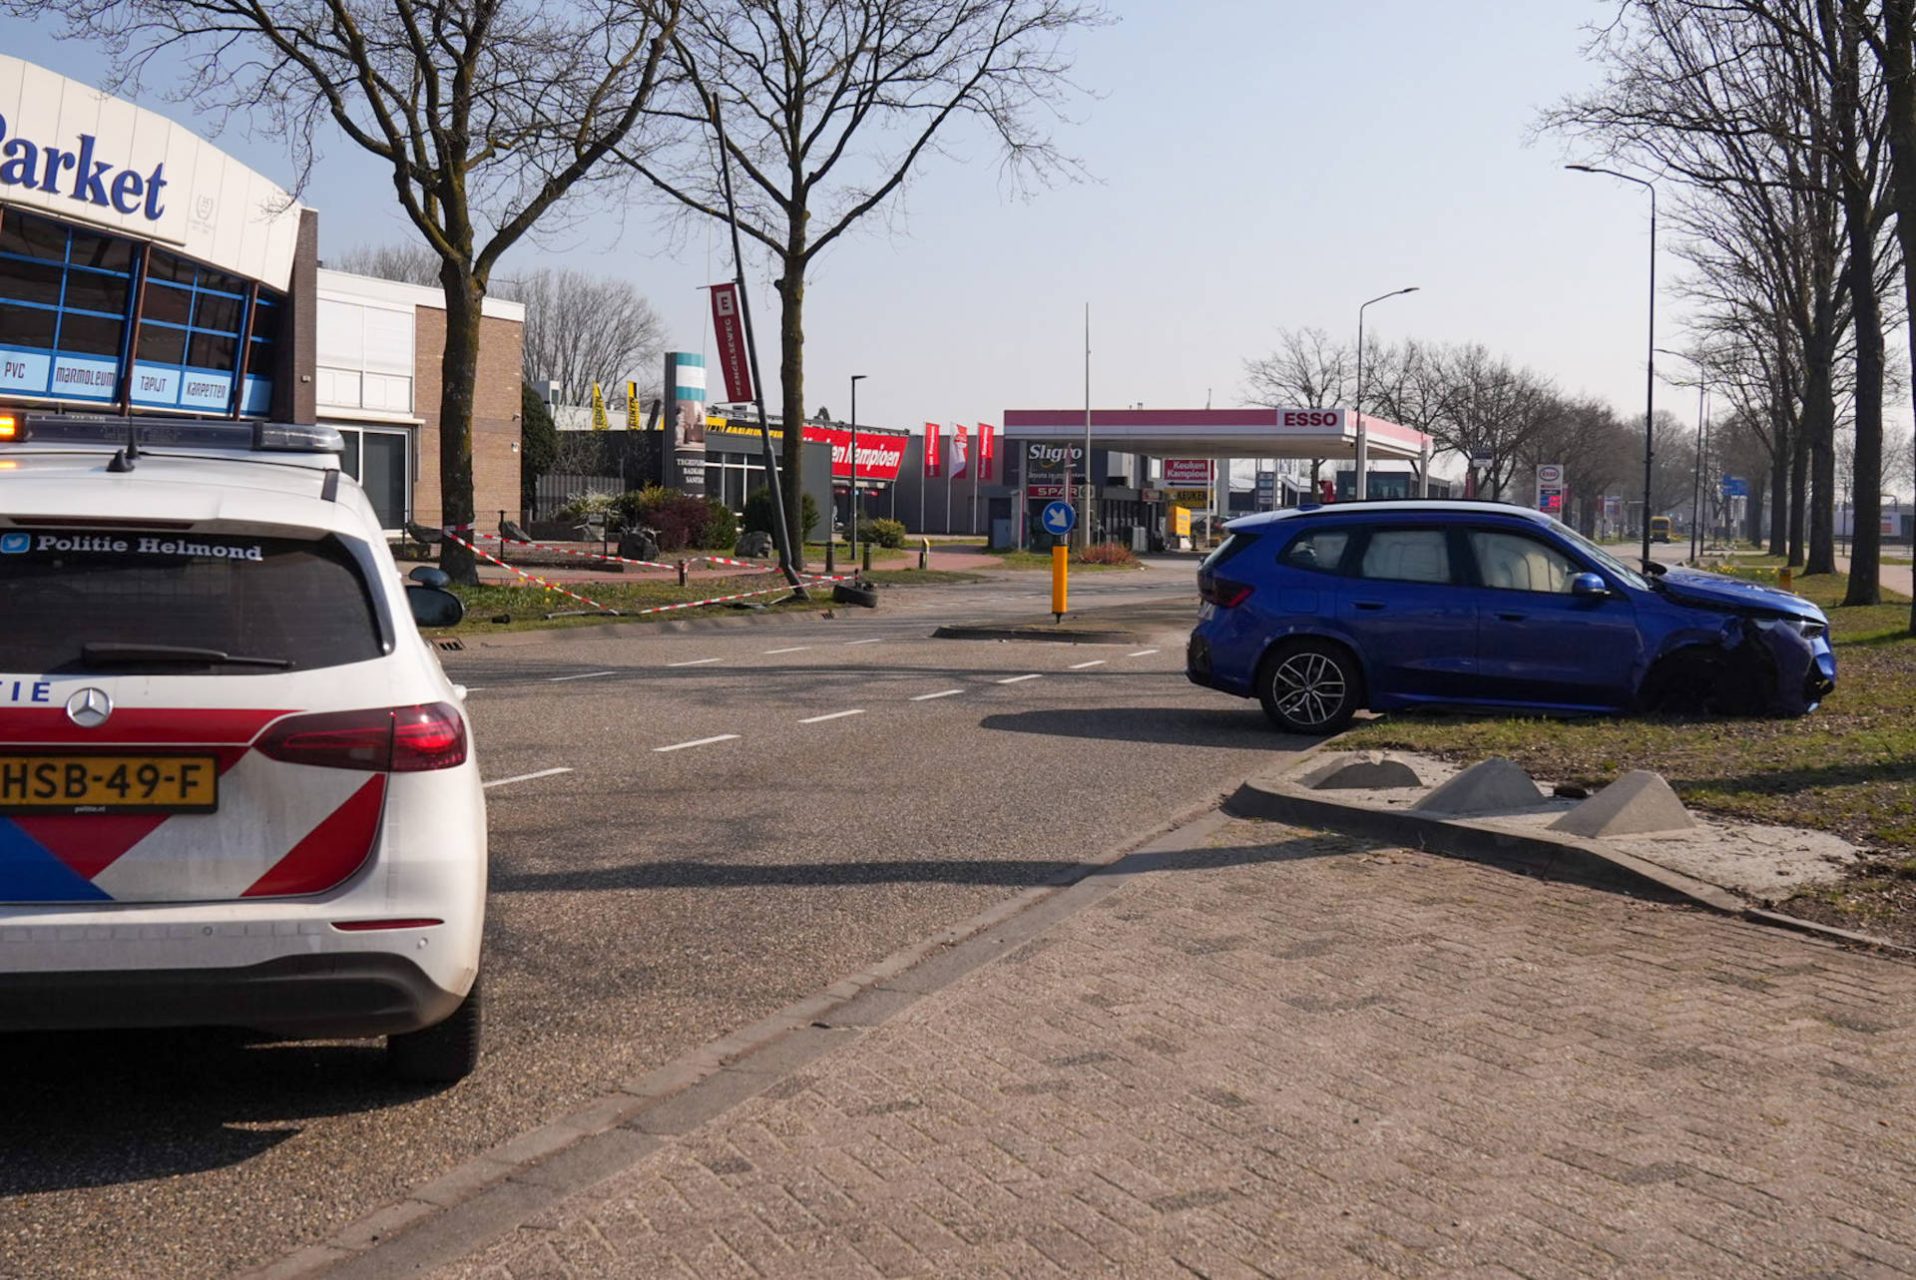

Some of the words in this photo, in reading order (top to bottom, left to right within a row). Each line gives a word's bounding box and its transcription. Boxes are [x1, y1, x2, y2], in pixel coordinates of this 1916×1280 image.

[0, 113, 167, 221] arket
[4, 361, 26, 379] PVC
[1284, 412, 1338, 427] ESSO
[1028, 444, 1082, 462] Sligro
[36, 535, 128, 551] Politie
[138, 537, 263, 561] Helmond
[0, 681, 50, 702] IE
[3, 763, 202, 798] HSB-49-F
